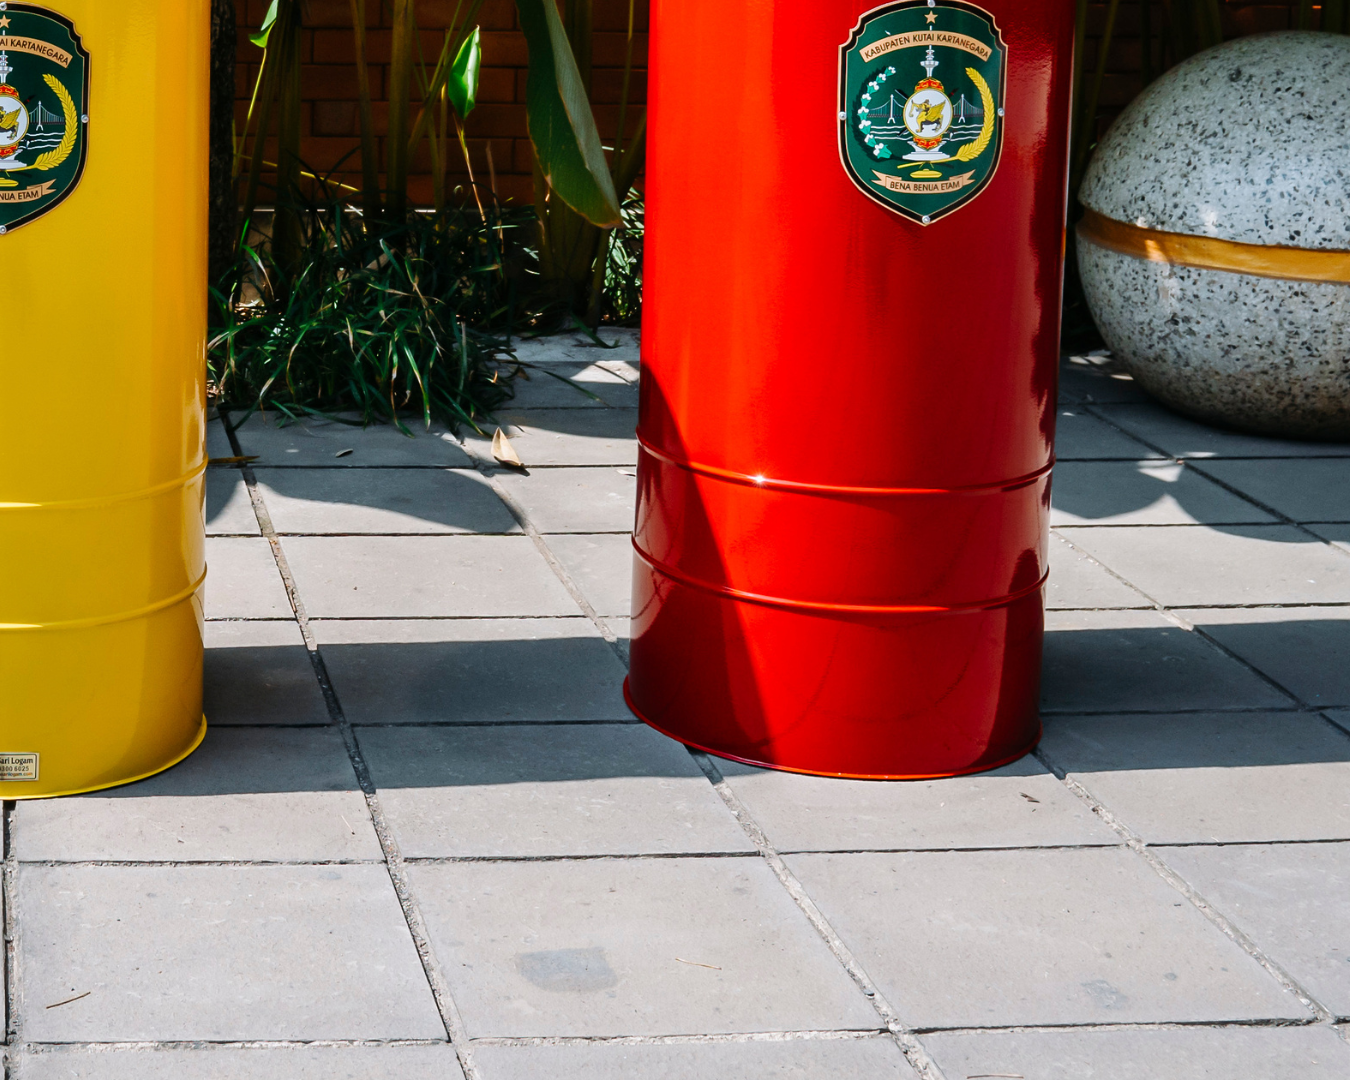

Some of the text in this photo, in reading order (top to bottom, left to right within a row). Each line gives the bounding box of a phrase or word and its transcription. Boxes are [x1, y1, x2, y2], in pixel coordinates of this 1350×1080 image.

[864, 33, 989, 59] KABUPATEN KUTAI KARTANEGARA
[10, 38, 69, 66] KARTANEGARA
[889, 180, 960, 191] BENA BENUA ETAM
[17, 189, 39, 200] ETAM
[11, 756, 34, 765] Logam
